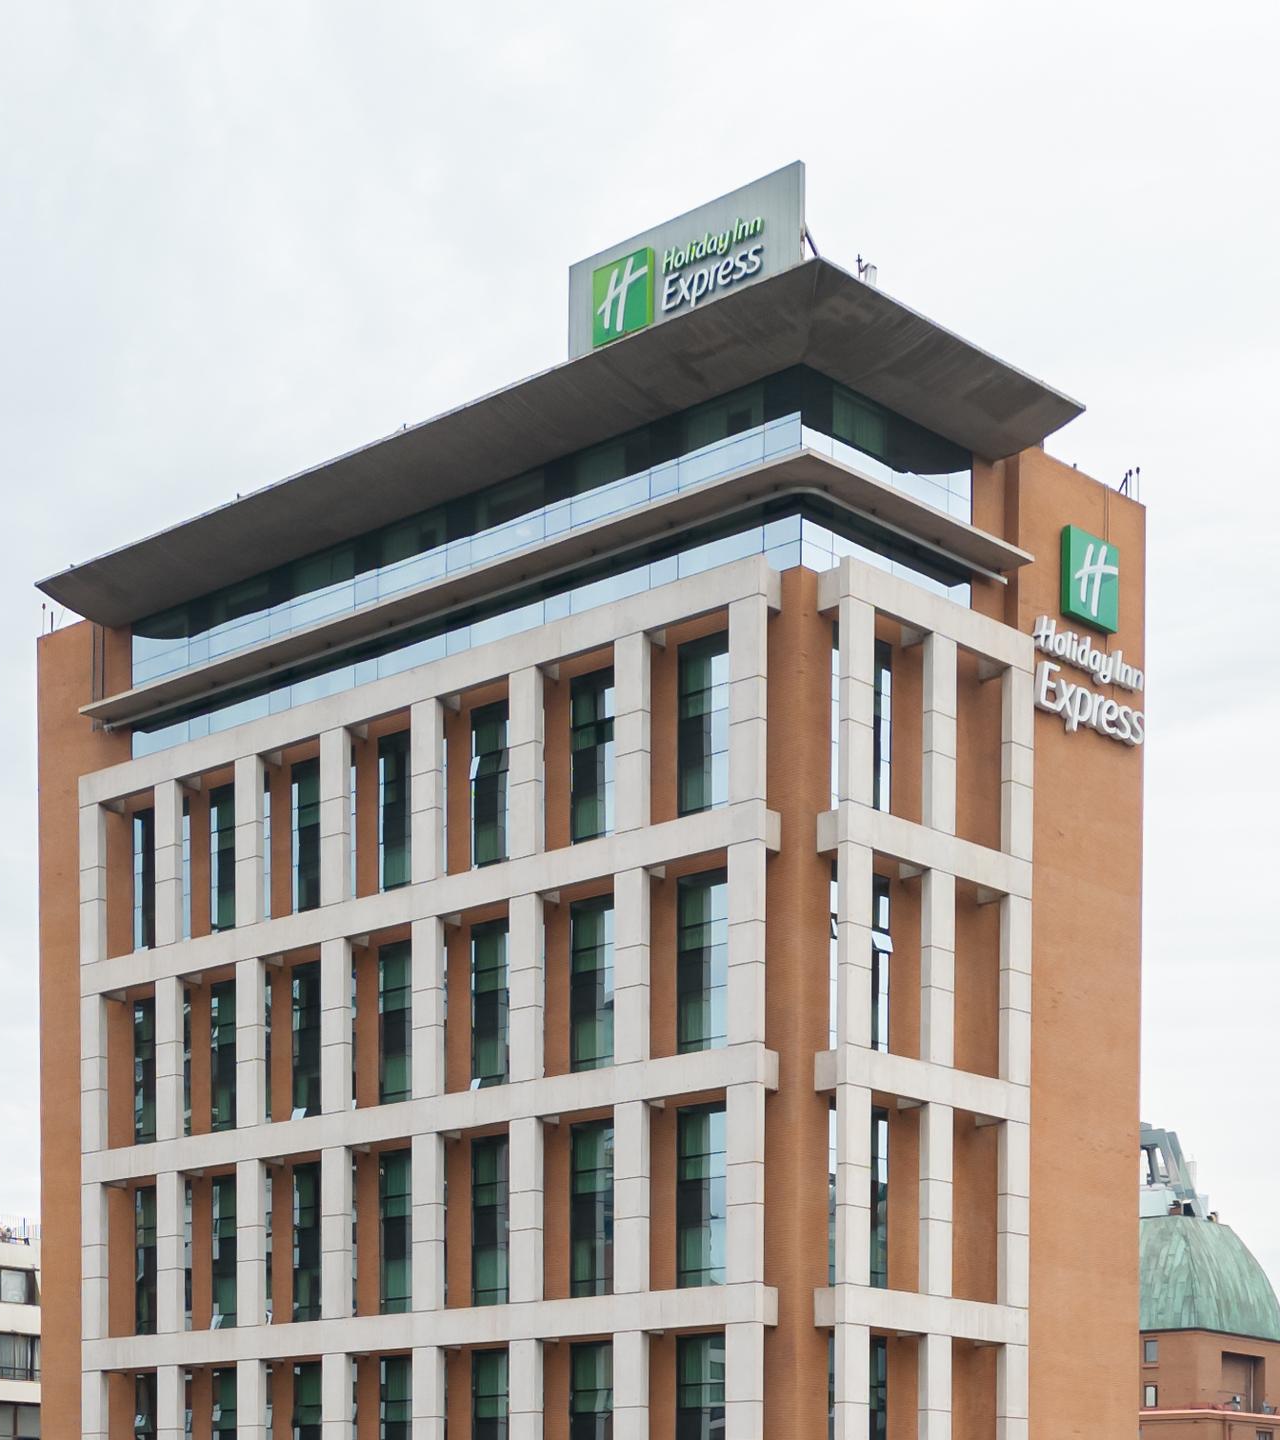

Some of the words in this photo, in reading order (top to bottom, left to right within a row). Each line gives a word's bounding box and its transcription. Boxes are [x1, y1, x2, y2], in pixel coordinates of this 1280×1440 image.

[661, 244, 763, 311] Express
[662, 231, 732, 274] Holiday
[732, 216, 763, 242] Inn
[1032, 615, 1112, 684] Holiday
[1111, 650, 1144, 693] Inn
[1034, 660, 1145, 746] Express
